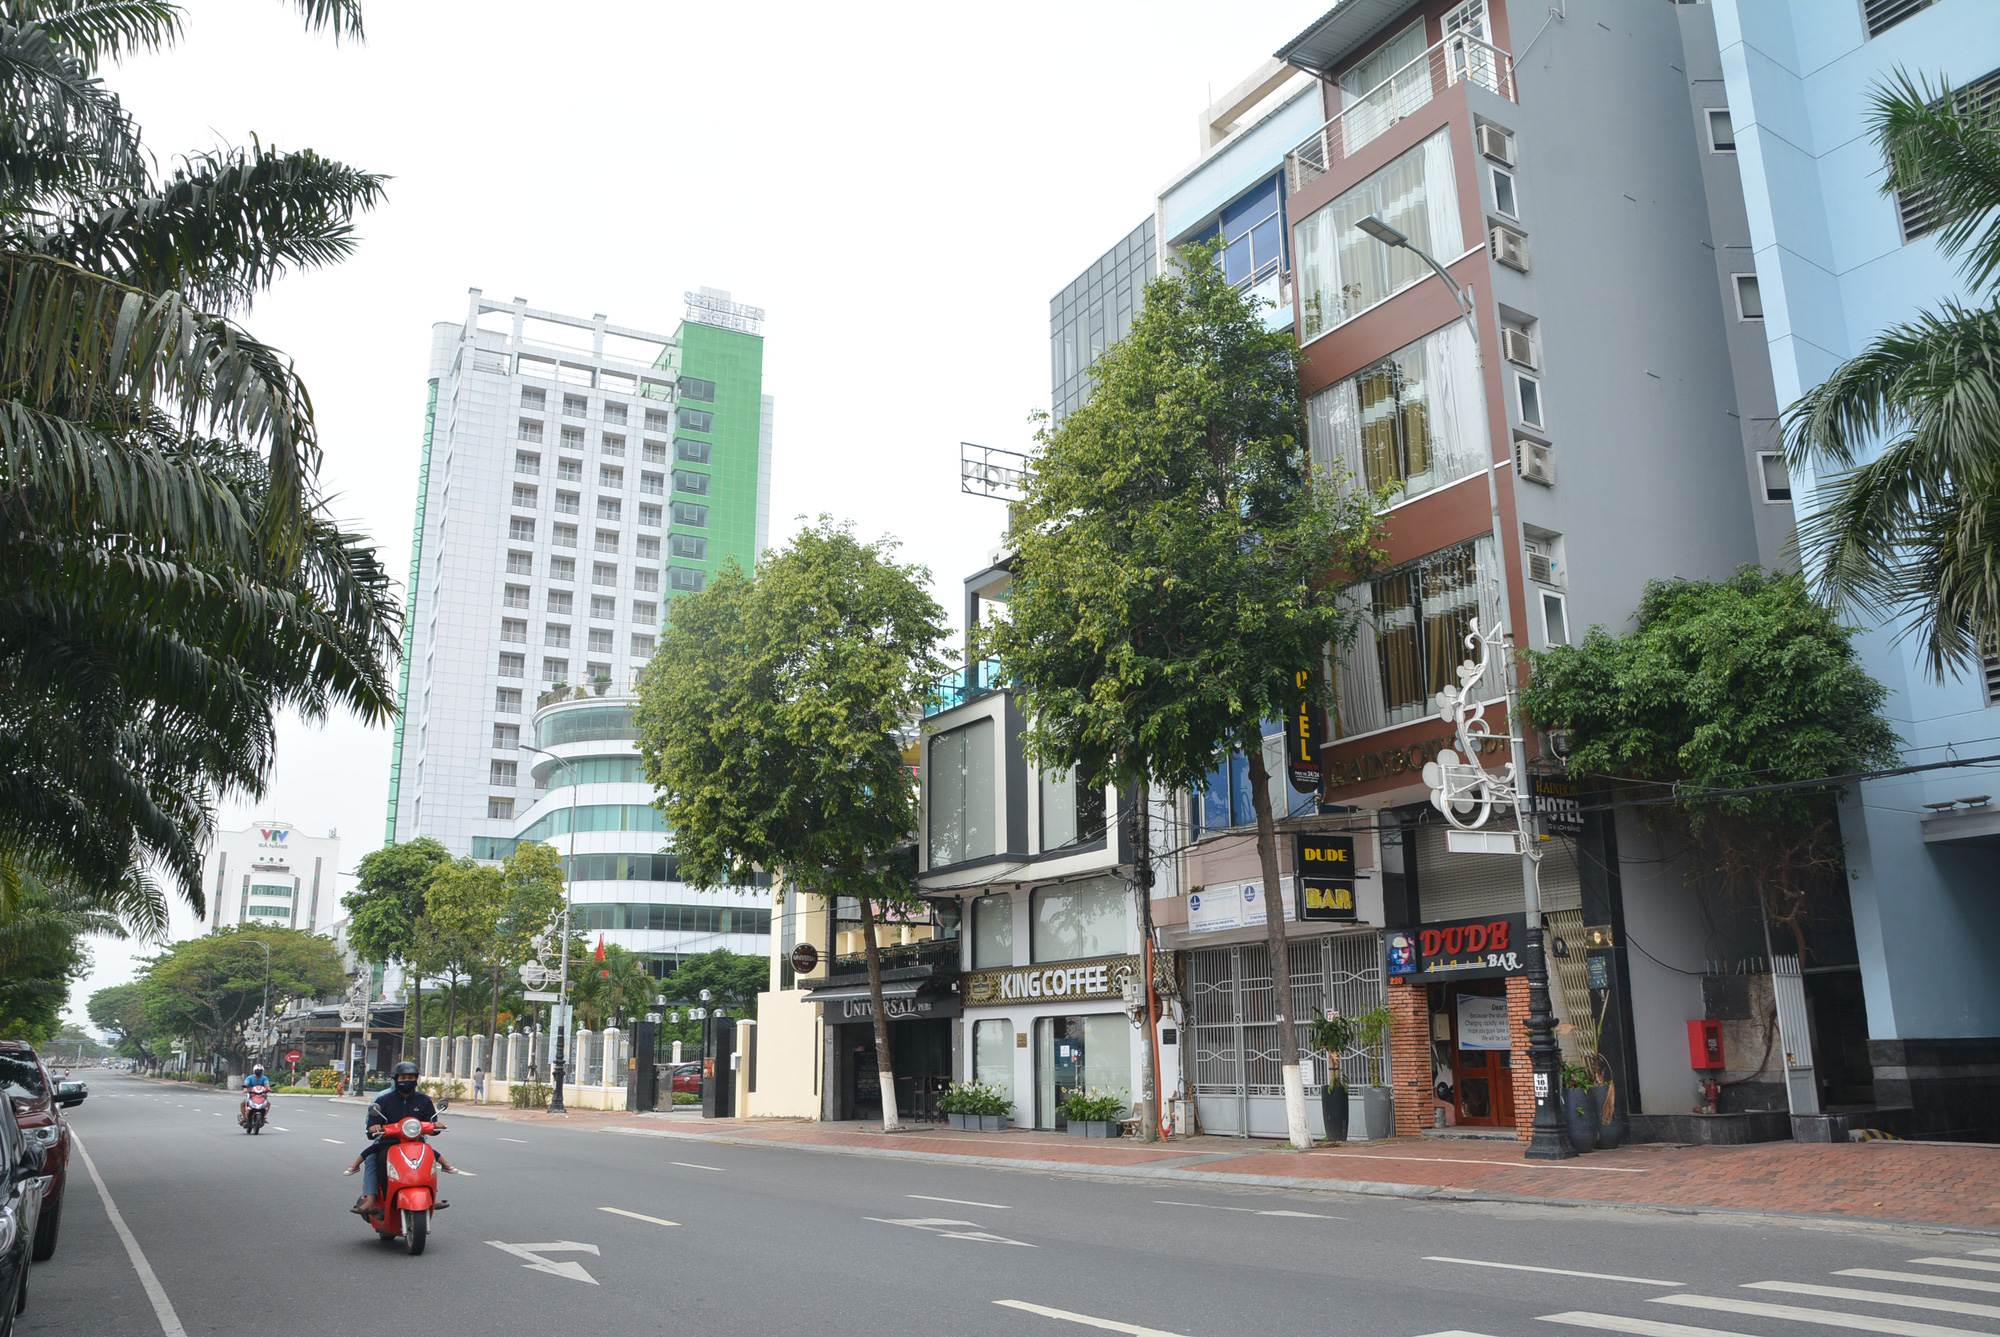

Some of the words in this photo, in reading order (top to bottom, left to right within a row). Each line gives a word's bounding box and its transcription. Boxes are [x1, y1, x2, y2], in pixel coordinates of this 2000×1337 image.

[1535, 795, 1585, 824] HOTEL
[260, 829, 289, 842] VTV
[1304, 848, 1348, 862] DUDE
[1305, 888, 1353, 910] BAR
[1419, 921, 1511, 957] DUDE
[1487, 951, 1524, 971] BAR
[1389, 977, 1403, 985] 220
[843, 999, 917, 1018] UNIVRSAL
